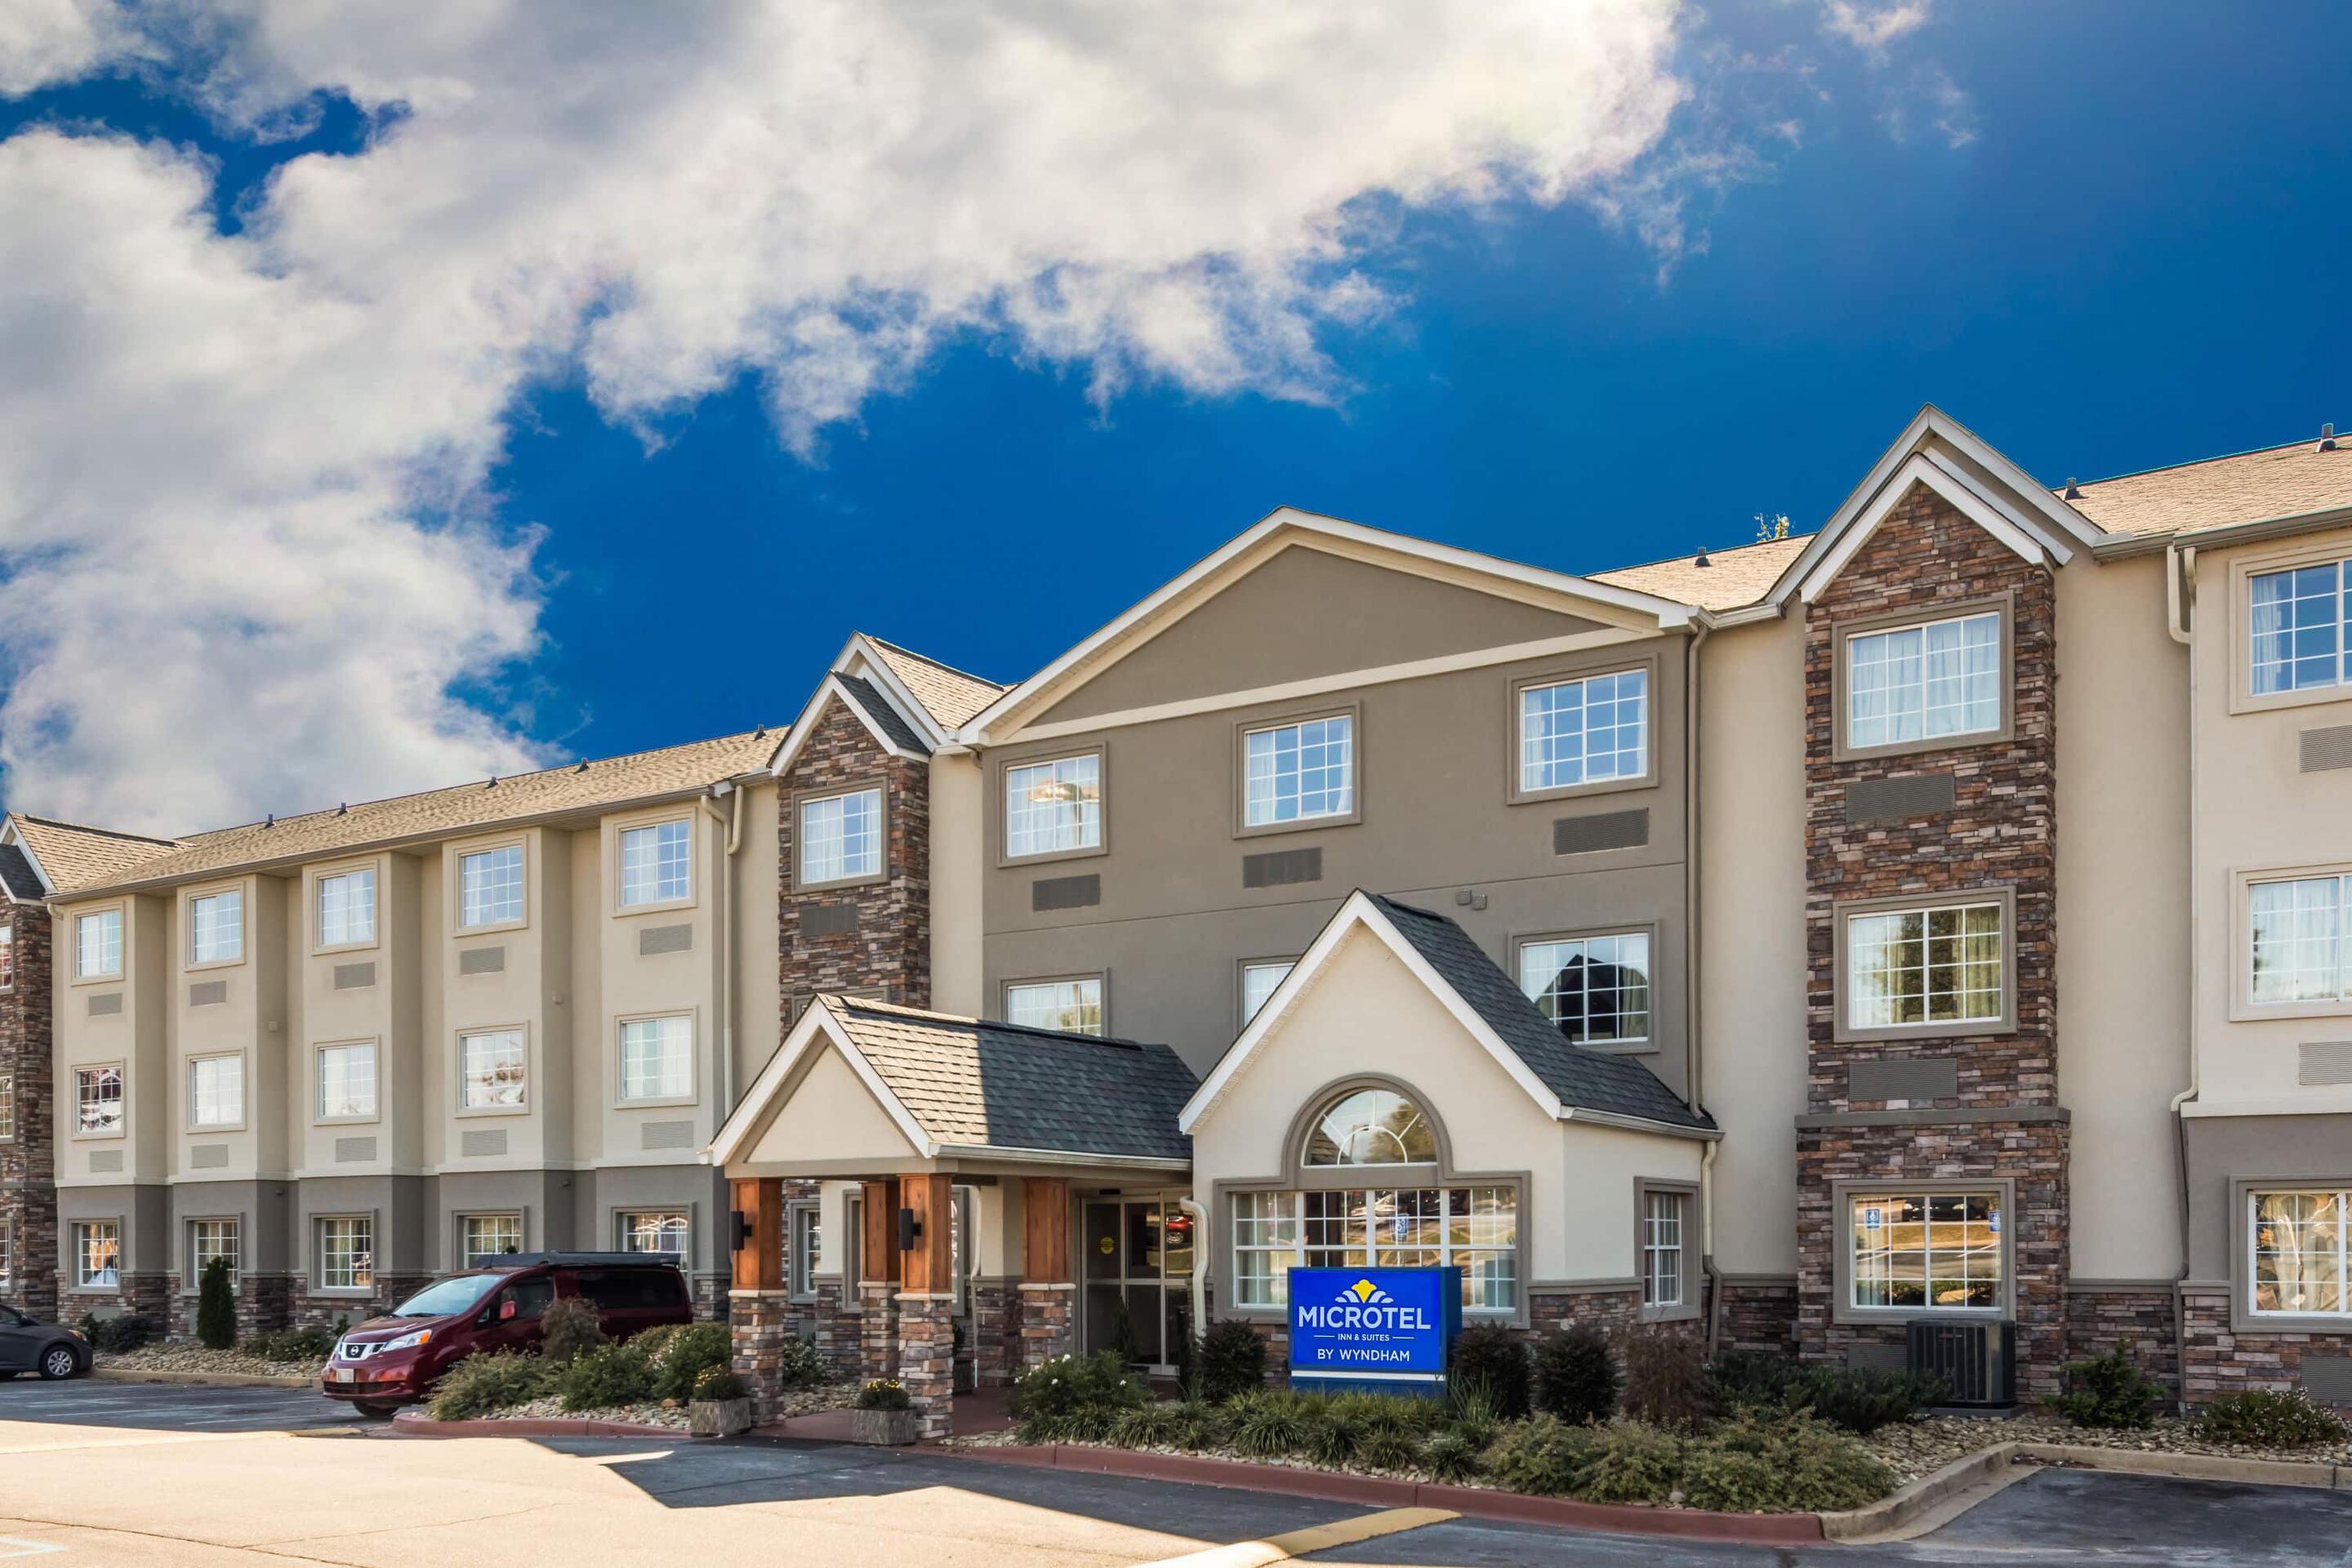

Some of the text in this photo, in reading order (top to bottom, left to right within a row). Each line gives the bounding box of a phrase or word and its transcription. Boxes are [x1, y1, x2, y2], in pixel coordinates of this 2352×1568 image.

[1298, 1306, 1432, 1330] MICROTEL
[1361, 1334, 1390, 1342] SUITES
[1317, 1348, 1410, 1362] BY WYNDHAM
